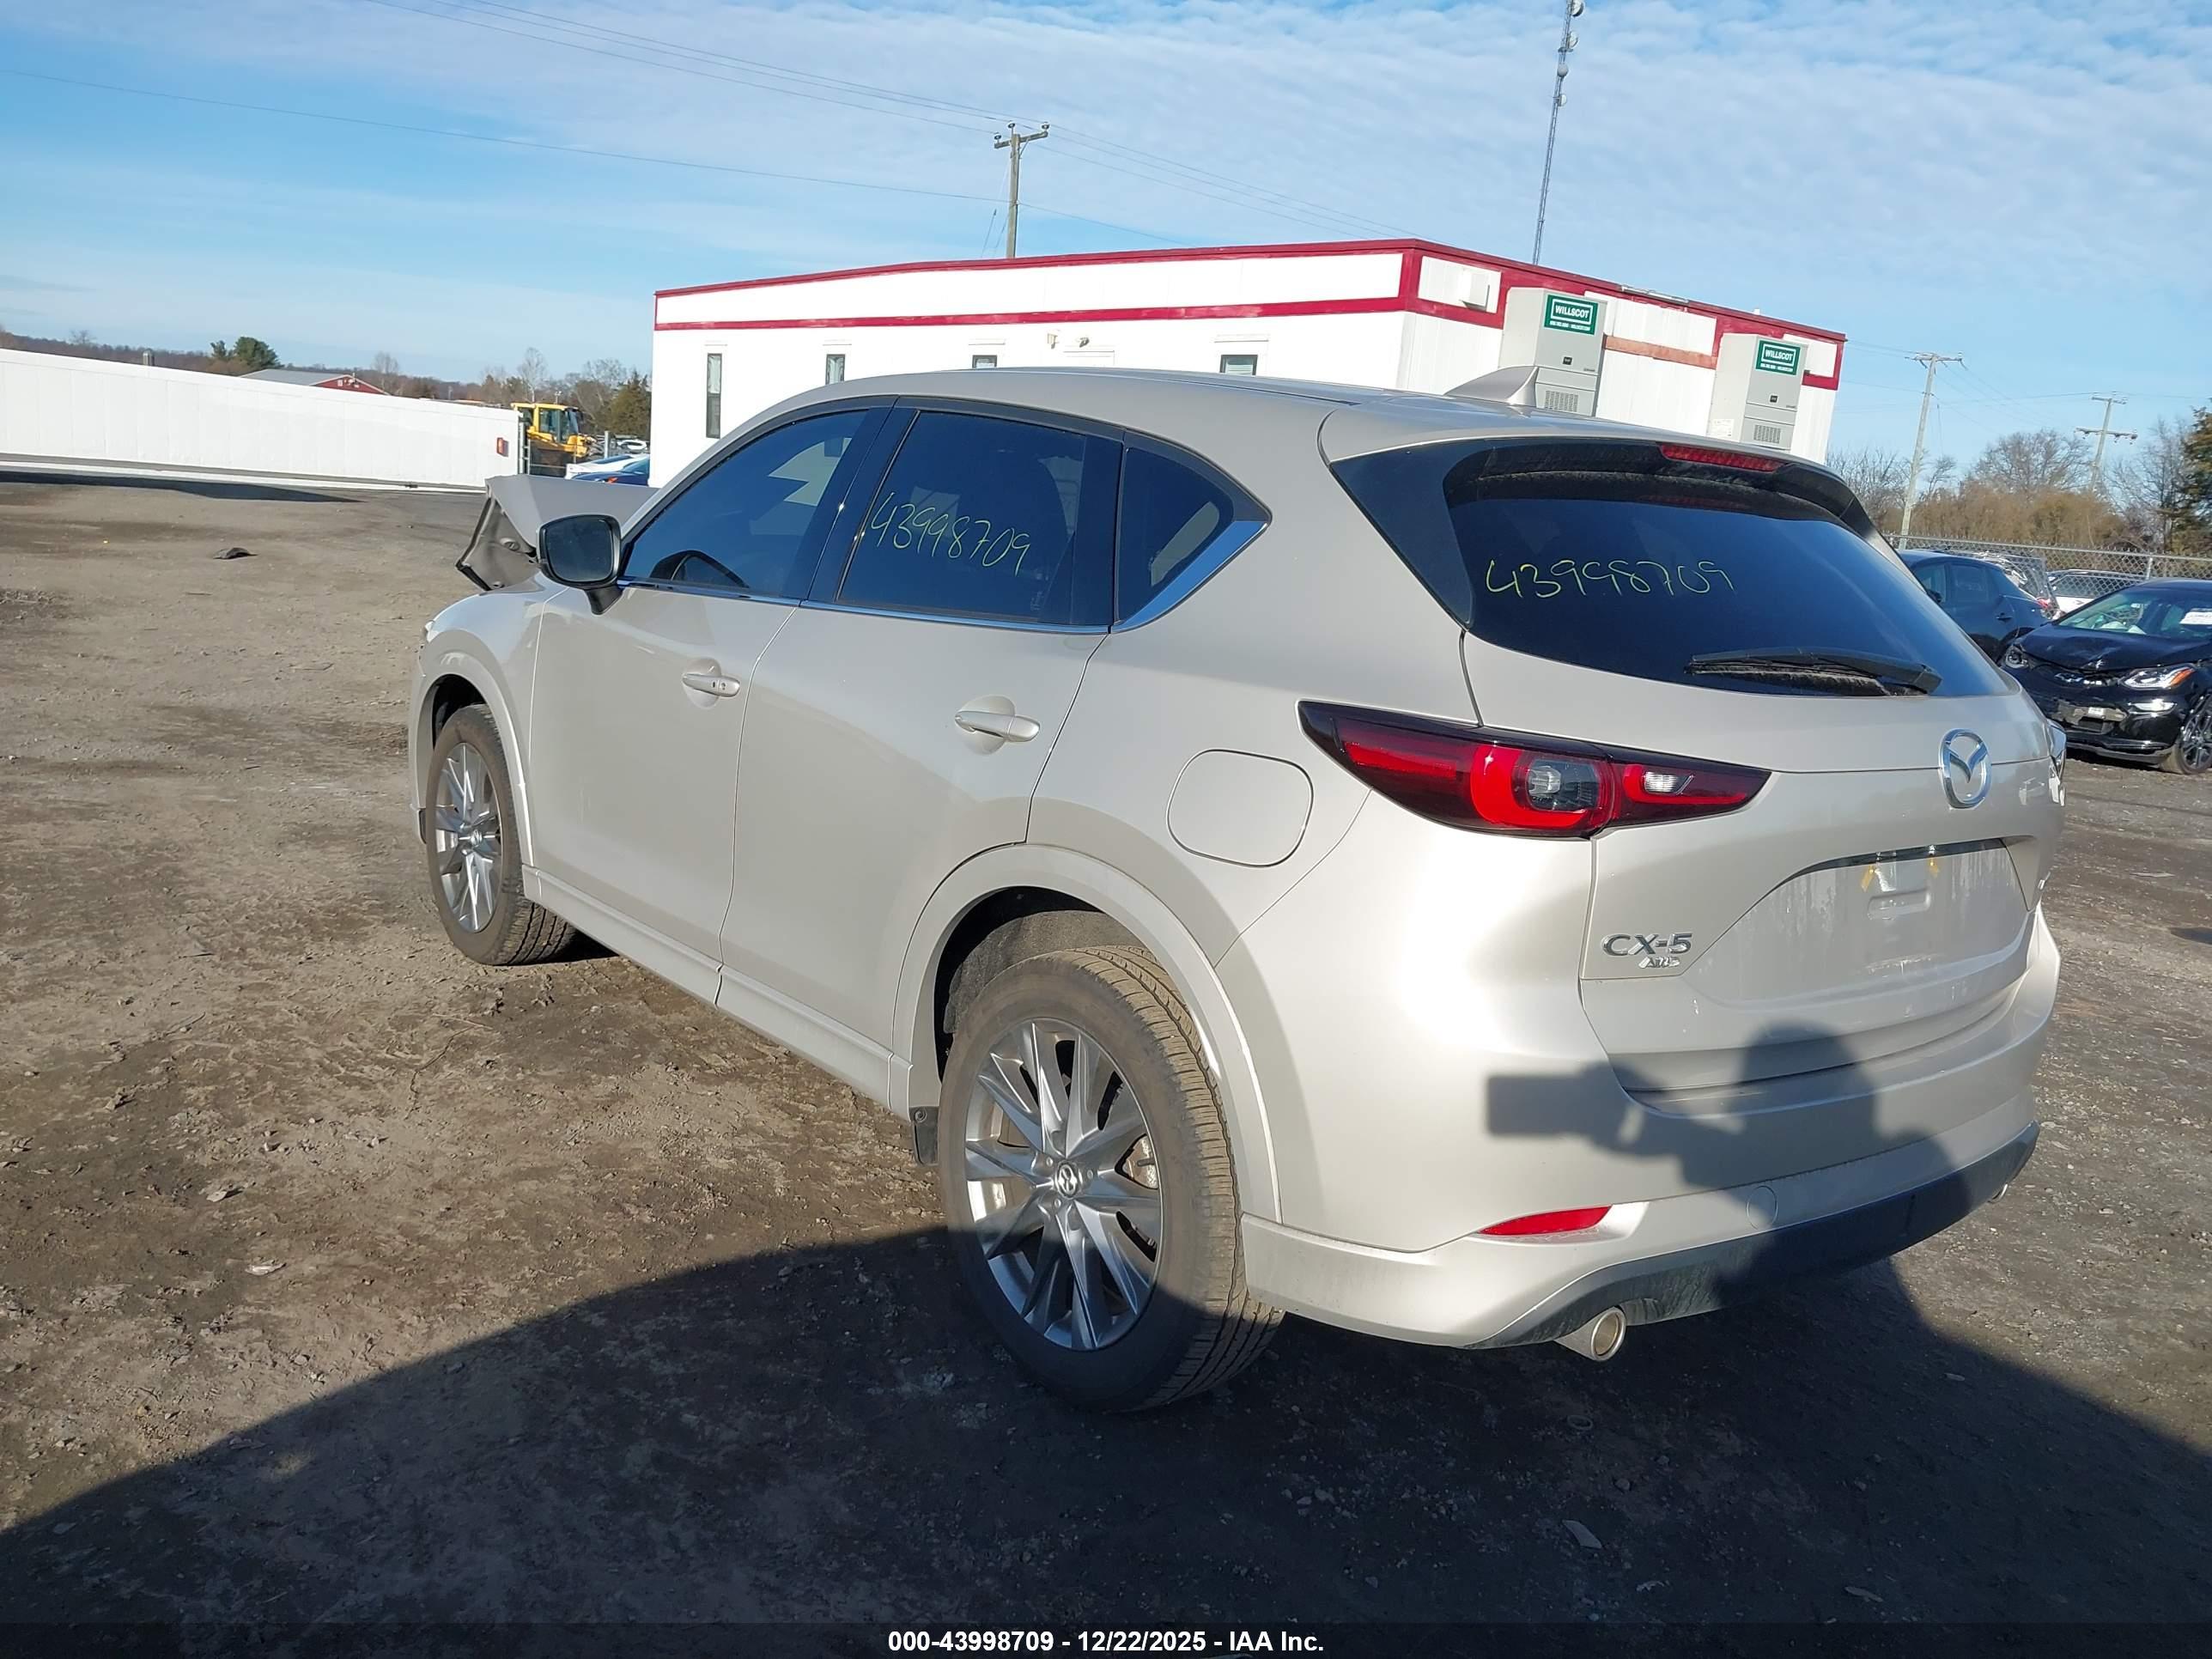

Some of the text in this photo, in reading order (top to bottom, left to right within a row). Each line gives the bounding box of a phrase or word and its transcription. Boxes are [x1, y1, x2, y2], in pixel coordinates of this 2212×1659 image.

[1555, 305, 1589, 319] WILLSCOT
[1765, 349, 1794, 361] WILLSCOT
[871, 492, 1031, 577] 43998709
[1485, 559, 1735, 599] 43998709
[1602, 933, 1692, 956] CX-5
